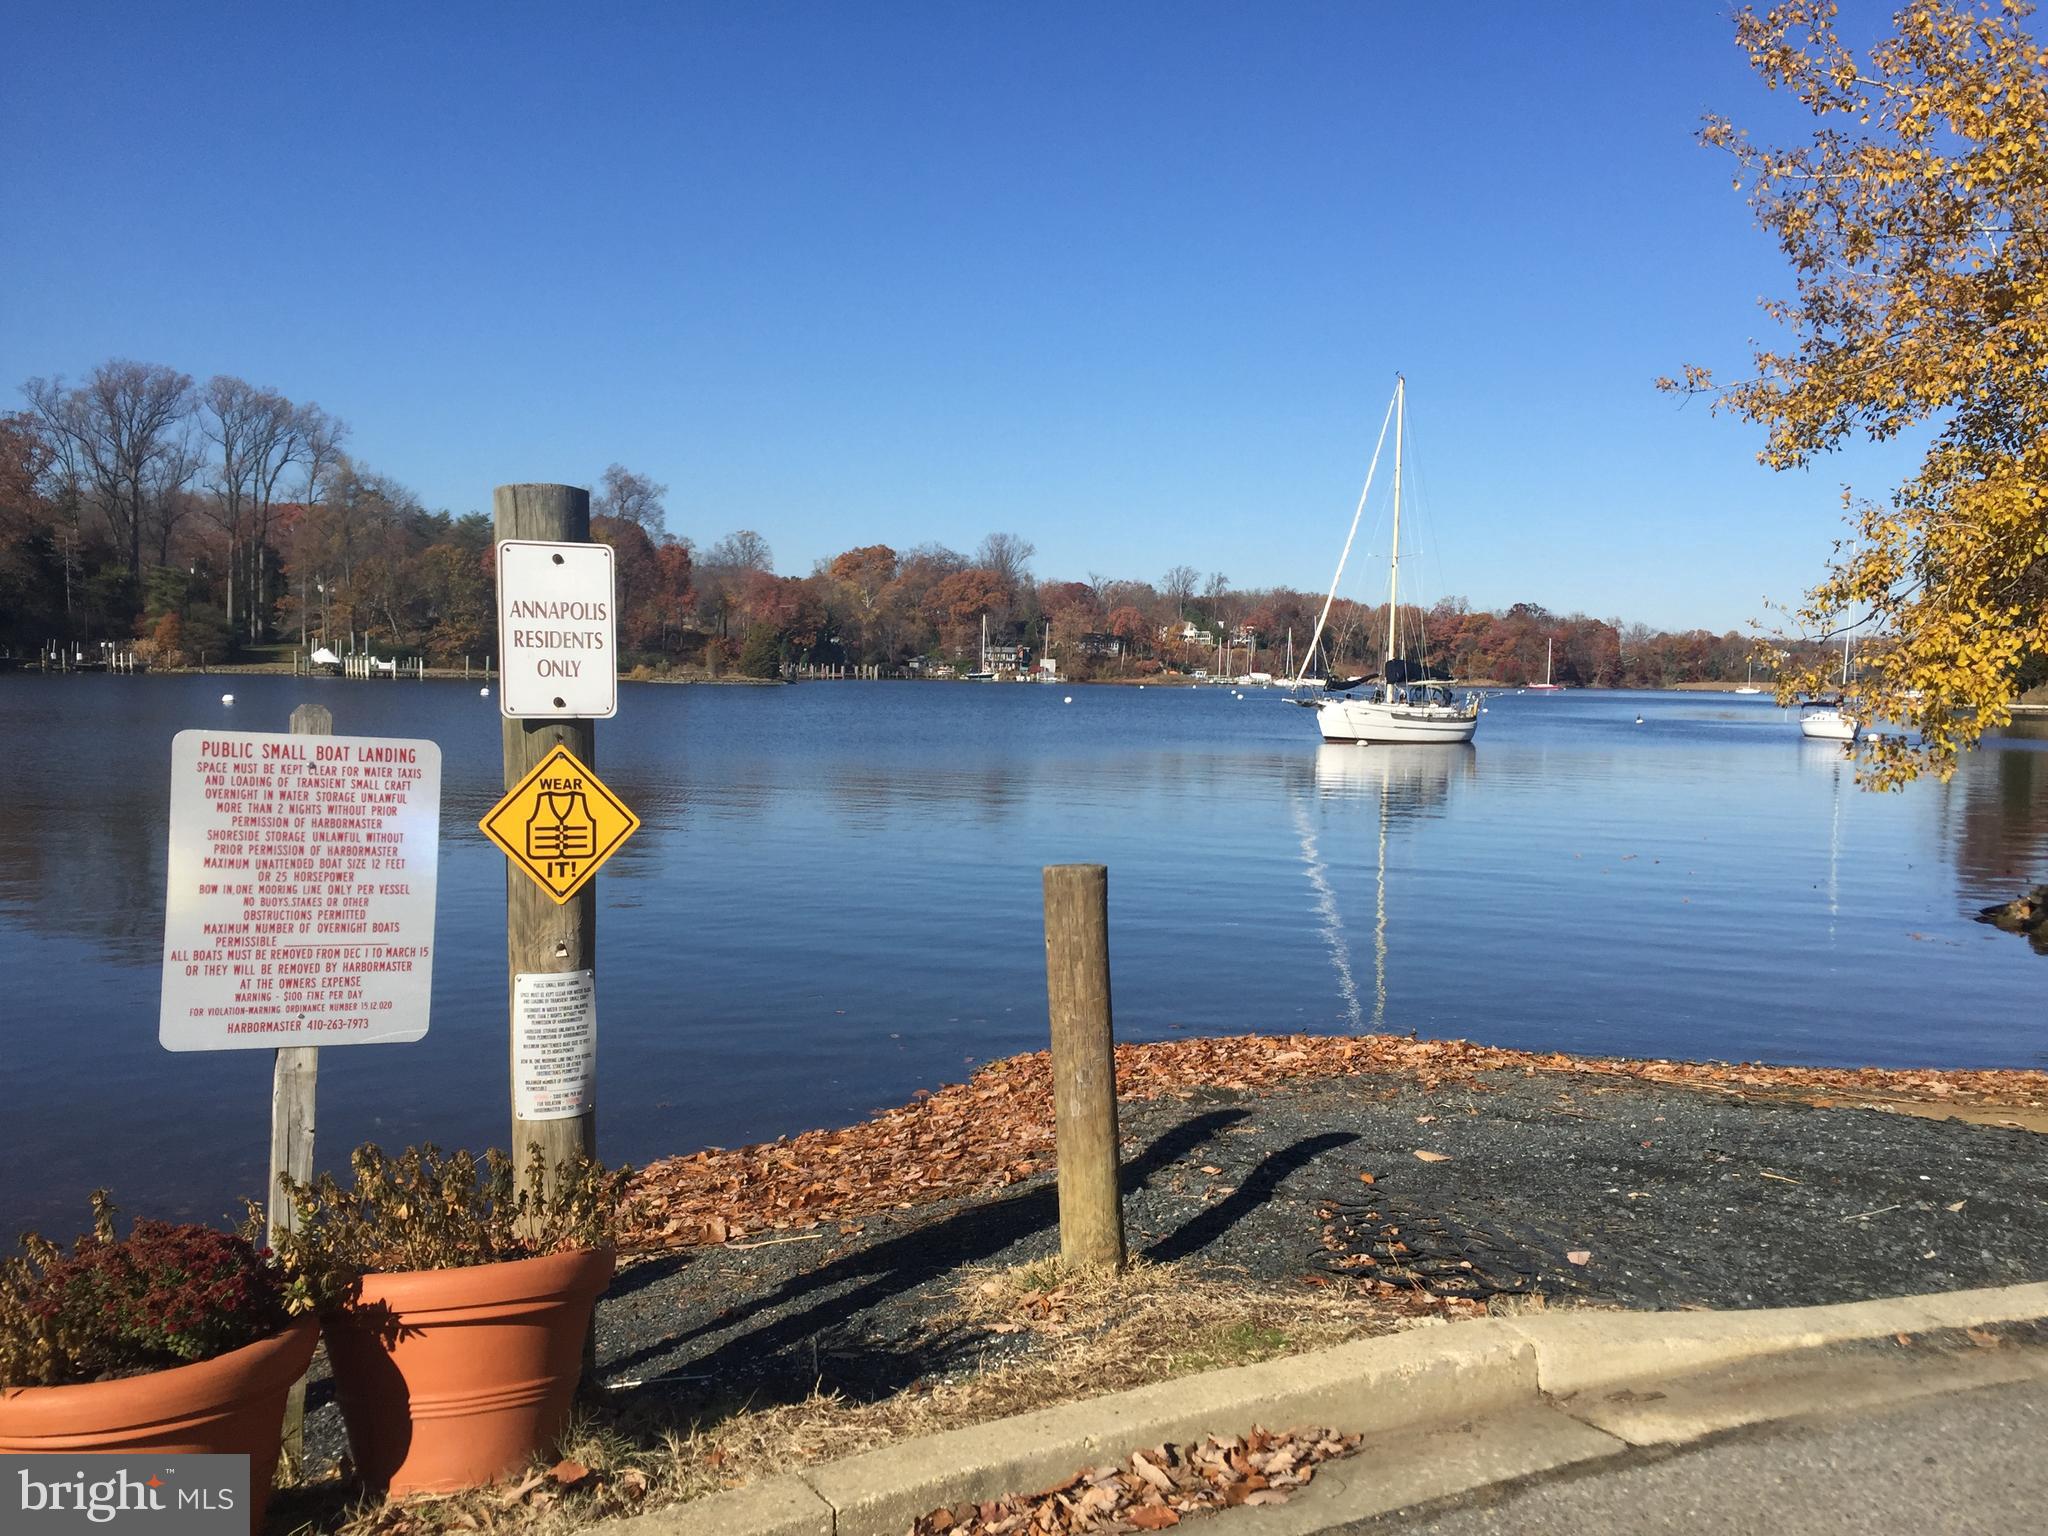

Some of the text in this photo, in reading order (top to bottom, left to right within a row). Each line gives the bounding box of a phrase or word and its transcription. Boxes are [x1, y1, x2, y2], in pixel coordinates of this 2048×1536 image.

[510, 600, 607, 620] ANNAPOLIS
[514, 630, 603, 649] RESIDENTS
[537, 659, 581, 677] ONLY
[202, 741, 416, 763] PUBLIC SMALL BOAT LANDING
[197, 761, 422, 779] SPACE MUST BE KEPT CLEAR FOR WATER TAXIS
[205, 776, 411, 791] AND LOADING OF TRANSIENT SMALL CRAFT
[540, 778, 582, 790] WEAR
[205, 790, 407, 804] OVERNIGHT IN WATER STORAGE UNLAWFUL
[216, 802, 397, 816] MORE THAN 2 NIGHTS WITHOUT PRIOR
[232, 817, 382, 829] PERMISSION OF HARBORMASTER
[207, 830, 404, 844] SHORESIDE STORAGE UNLAWFUL WITHOUT
[214, 844, 398, 857] PRIOR PERMISSION OF HARBORMASTER
[204, 858, 405, 869] MAXIMUM UNATTENDED BOAT SIZE 12 FEET
[547, 862, 576, 878] IT!
[258, 872, 354, 882] OR 25 HORSEPOWER
[199, 884, 218, 895] BOW
[258, 884, 297, 895] MOORING
[303, 885, 322, 895] LINE
[327, 884, 351, 895] ONLY
[357, 885, 374, 895] PER
[379, 884, 410, 895] VESSEL
[243, 898, 254, 907] NO
[327, 897, 338, 907] OR
[343, 897, 369, 907] OTHER
[243, 910, 365, 921] OBSTRUCTIONS PERMITTED
[204, 922, 400, 934] MAXIMUM NUMBER OF OVERNIGHT BOATS
[215, 936, 277, 947] PERMISSIBLE
[171, 947, 429, 961] ALL BOATS MUST BE REMOVED FROM DEC 1 TO MARCH 15
[185, 961, 412, 976] OR THEY WILL BE REMOVED BY HARBORMASTER
[240, 977, 361, 990] AT THE OWNERS EXPENSE
[235, 992, 272, 1002] WARNING
[284, 991, 303, 1001] $100
[307, 991, 324, 1000] FINE
[329, 990, 343, 1000] PER
[348, 990, 363, 999] DAY
[189, 1008, 204, 1017] FOR
[286, 1003, 325, 1014] ORDINANCE
[329, 1003, 358, 1012] NUMBER
[227, 1018, 369, 1034] HARBORMASTER 410-263-7973
